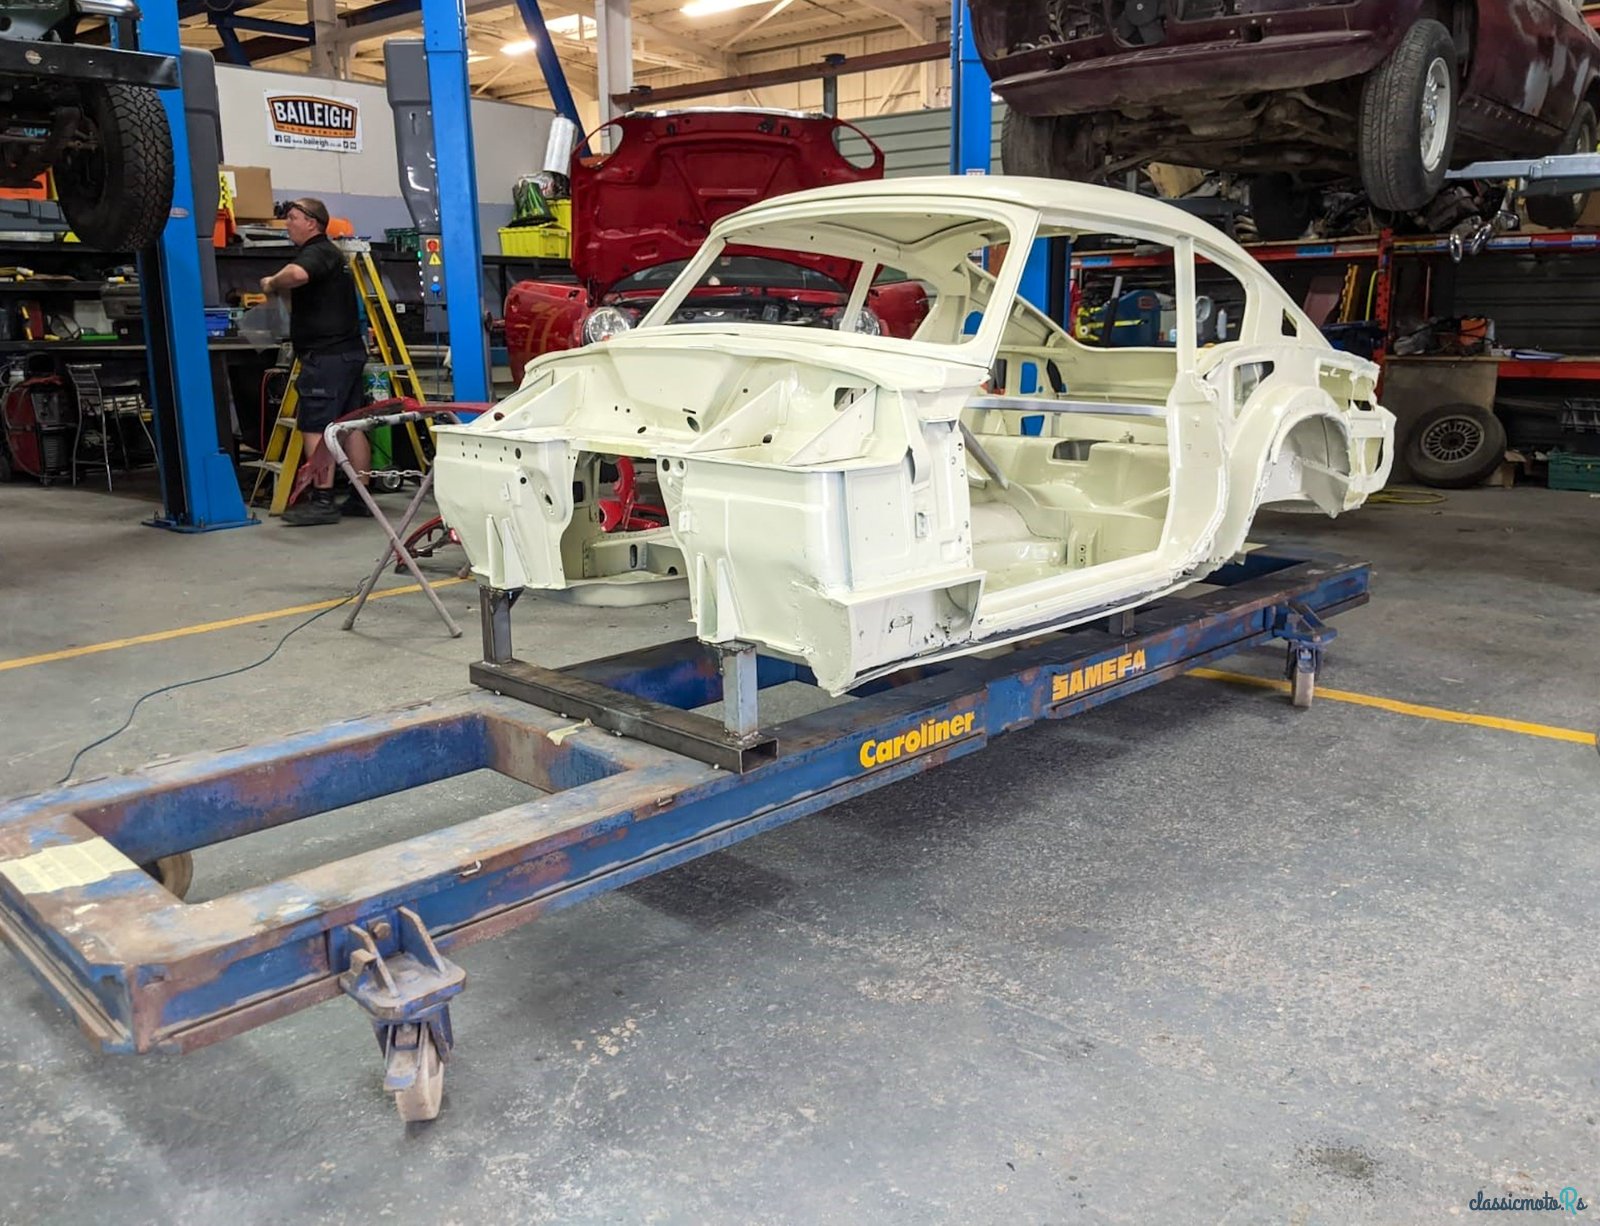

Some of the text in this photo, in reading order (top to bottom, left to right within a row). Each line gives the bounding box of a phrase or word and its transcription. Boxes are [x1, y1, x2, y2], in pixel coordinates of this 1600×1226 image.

[273, 101, 353, 129] BAILEIGH
[1052, 649, 1147, 701] SAMEFA
[859, 711, 976, 769] Caroliner
